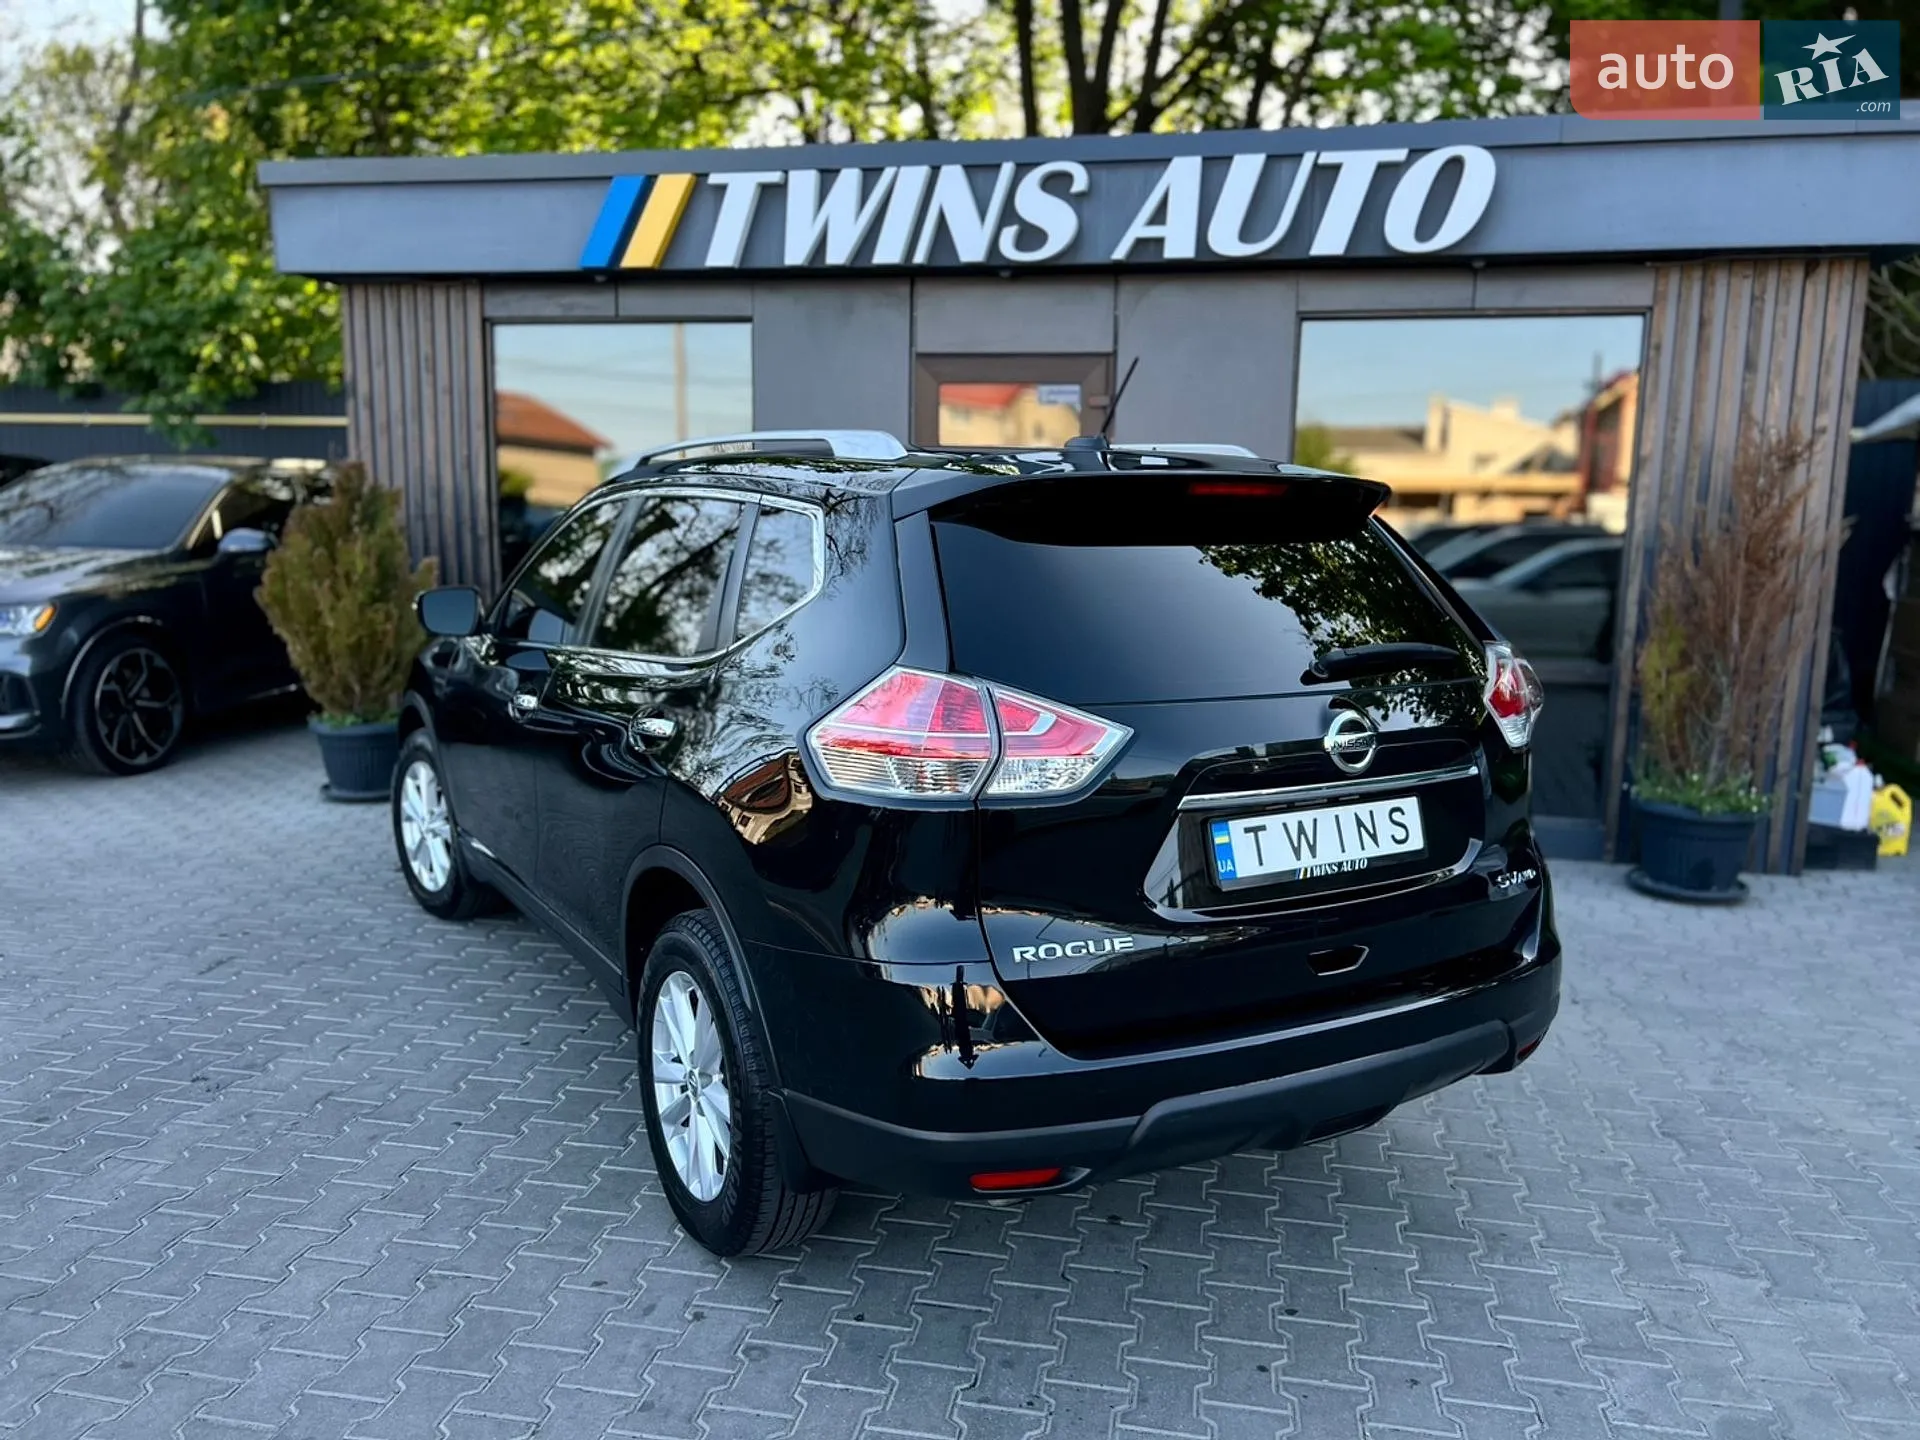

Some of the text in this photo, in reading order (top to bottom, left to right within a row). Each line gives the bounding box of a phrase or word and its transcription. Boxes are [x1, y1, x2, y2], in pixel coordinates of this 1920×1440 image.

[704, 144, 1497, 268] TWINS AUTO
[1243, 806, 1410, 867] TWINS
[1218, 859, 1235, 873] UA
[1307, 857, 1368, 879] TWINS AUTO
[1012, 936, 1135, 963] ROGUE
